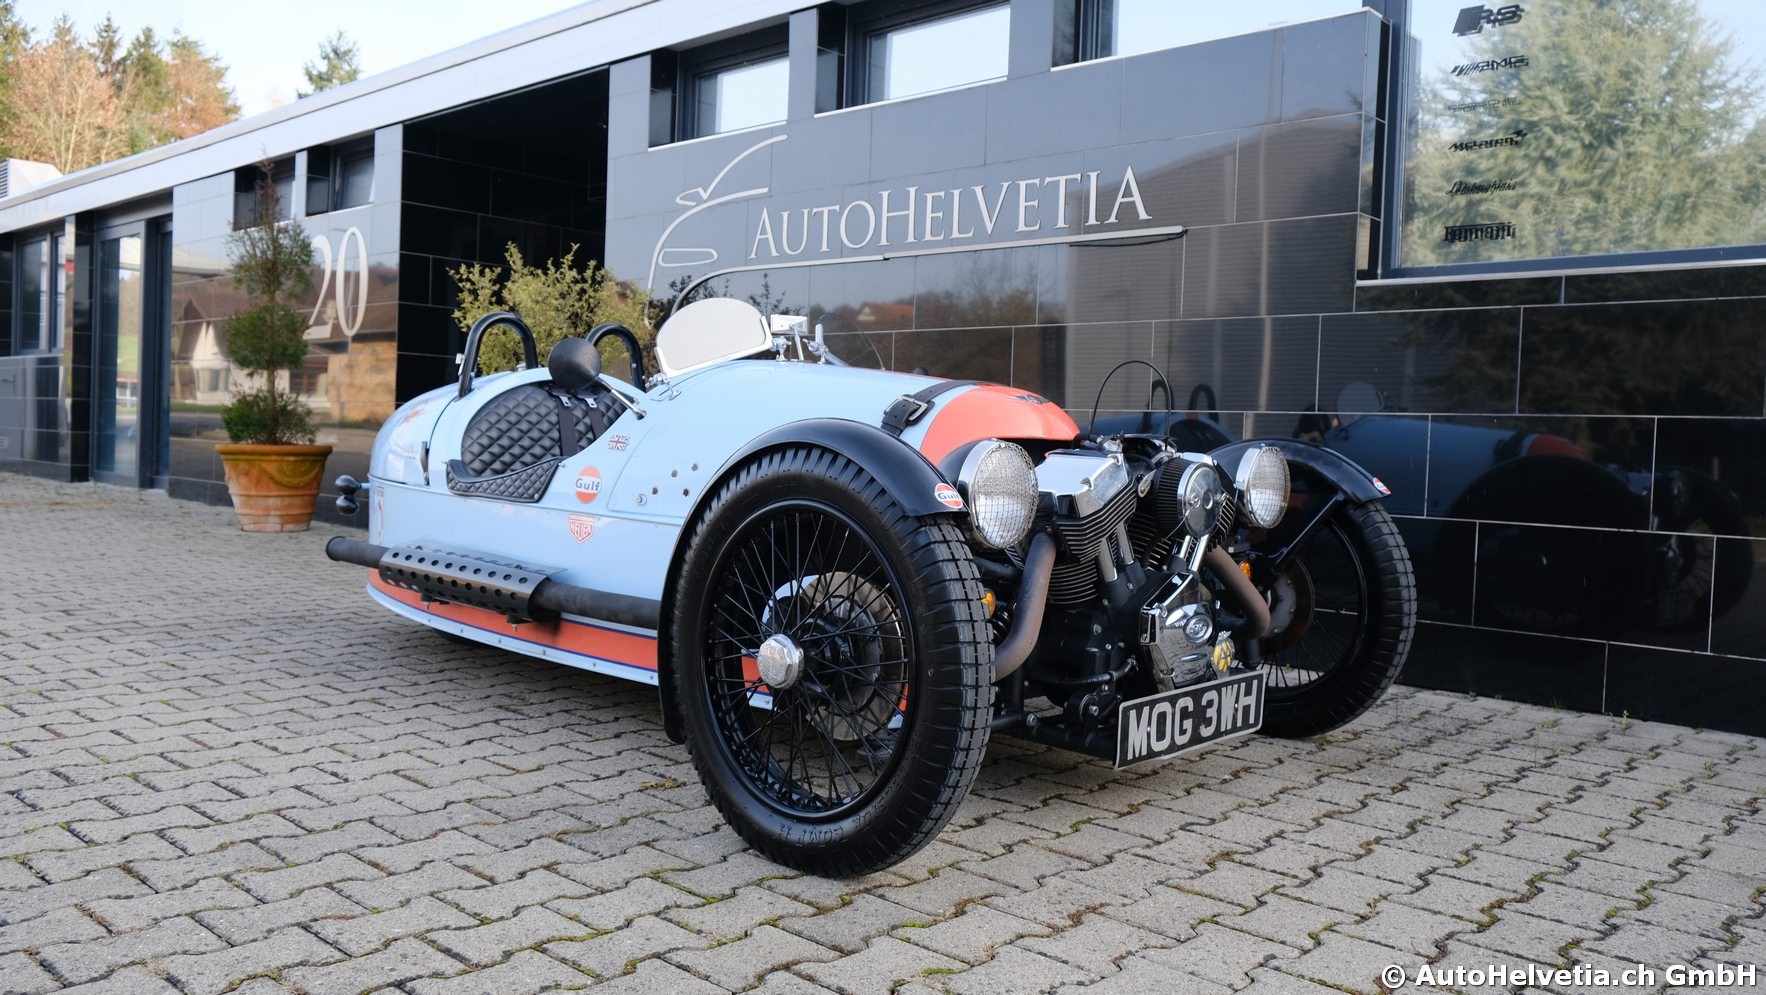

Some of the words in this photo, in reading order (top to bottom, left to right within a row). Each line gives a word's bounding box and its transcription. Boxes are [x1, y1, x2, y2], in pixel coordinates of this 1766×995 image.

[303, 226, 369, 341] 20
[575, 478, 600, 491] Gulf
[938, 492, 959, 500] Gulf
[1127, 696, 1194, 760] MOG
[1200, 679, 1258, 738] 3WH
